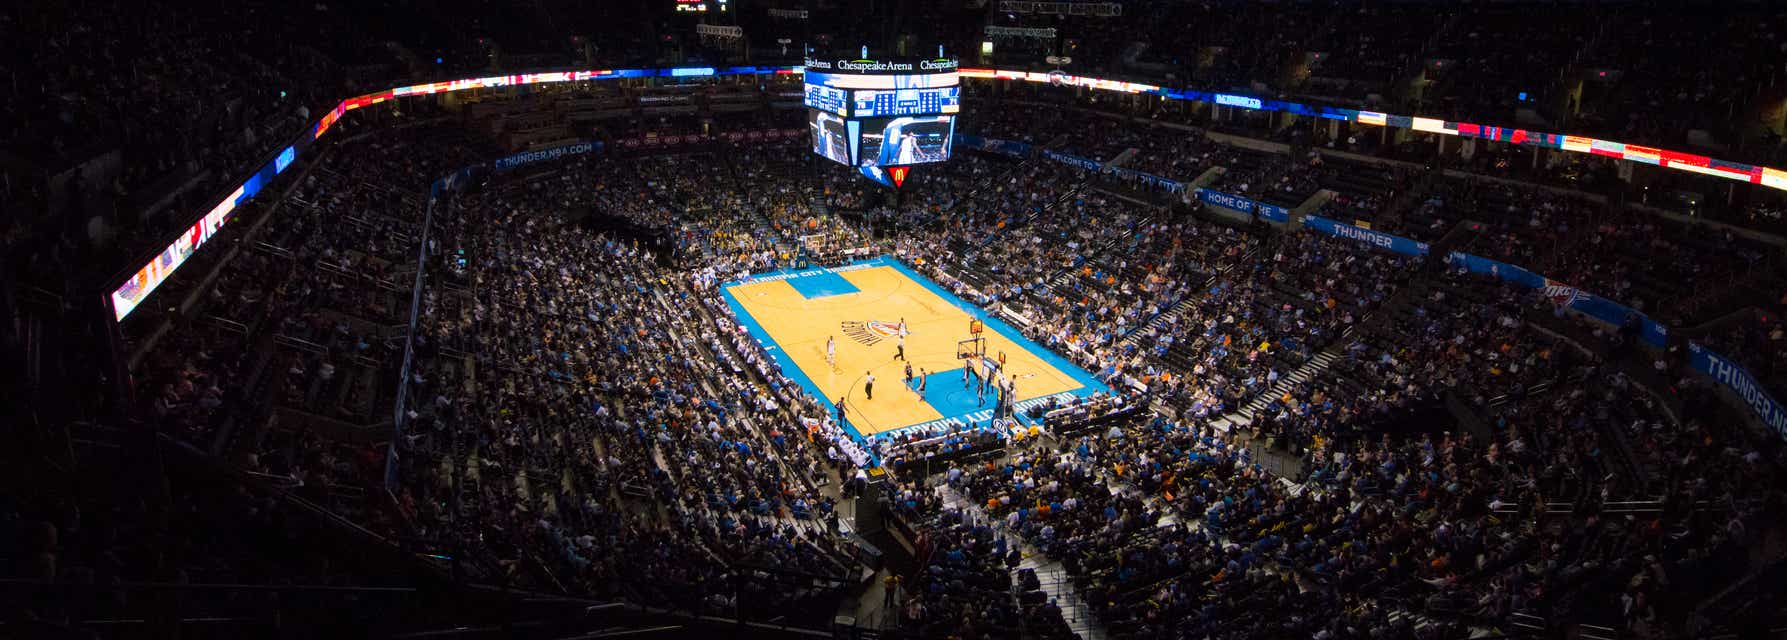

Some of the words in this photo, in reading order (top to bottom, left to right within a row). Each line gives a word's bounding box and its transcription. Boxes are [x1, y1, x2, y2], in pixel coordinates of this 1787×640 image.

[838, 60, 888, 73] Chesapeake
[887, 61, 913, 70] Arena
[1050, 152, 1083, 167] WELCOME
[1208, 192, 1235, 208] HOME
[1236, 200, 1251, 211] OF
[1334, 224, 1393, 249] THUNDER
[799, 270, 823, 278] CITY
